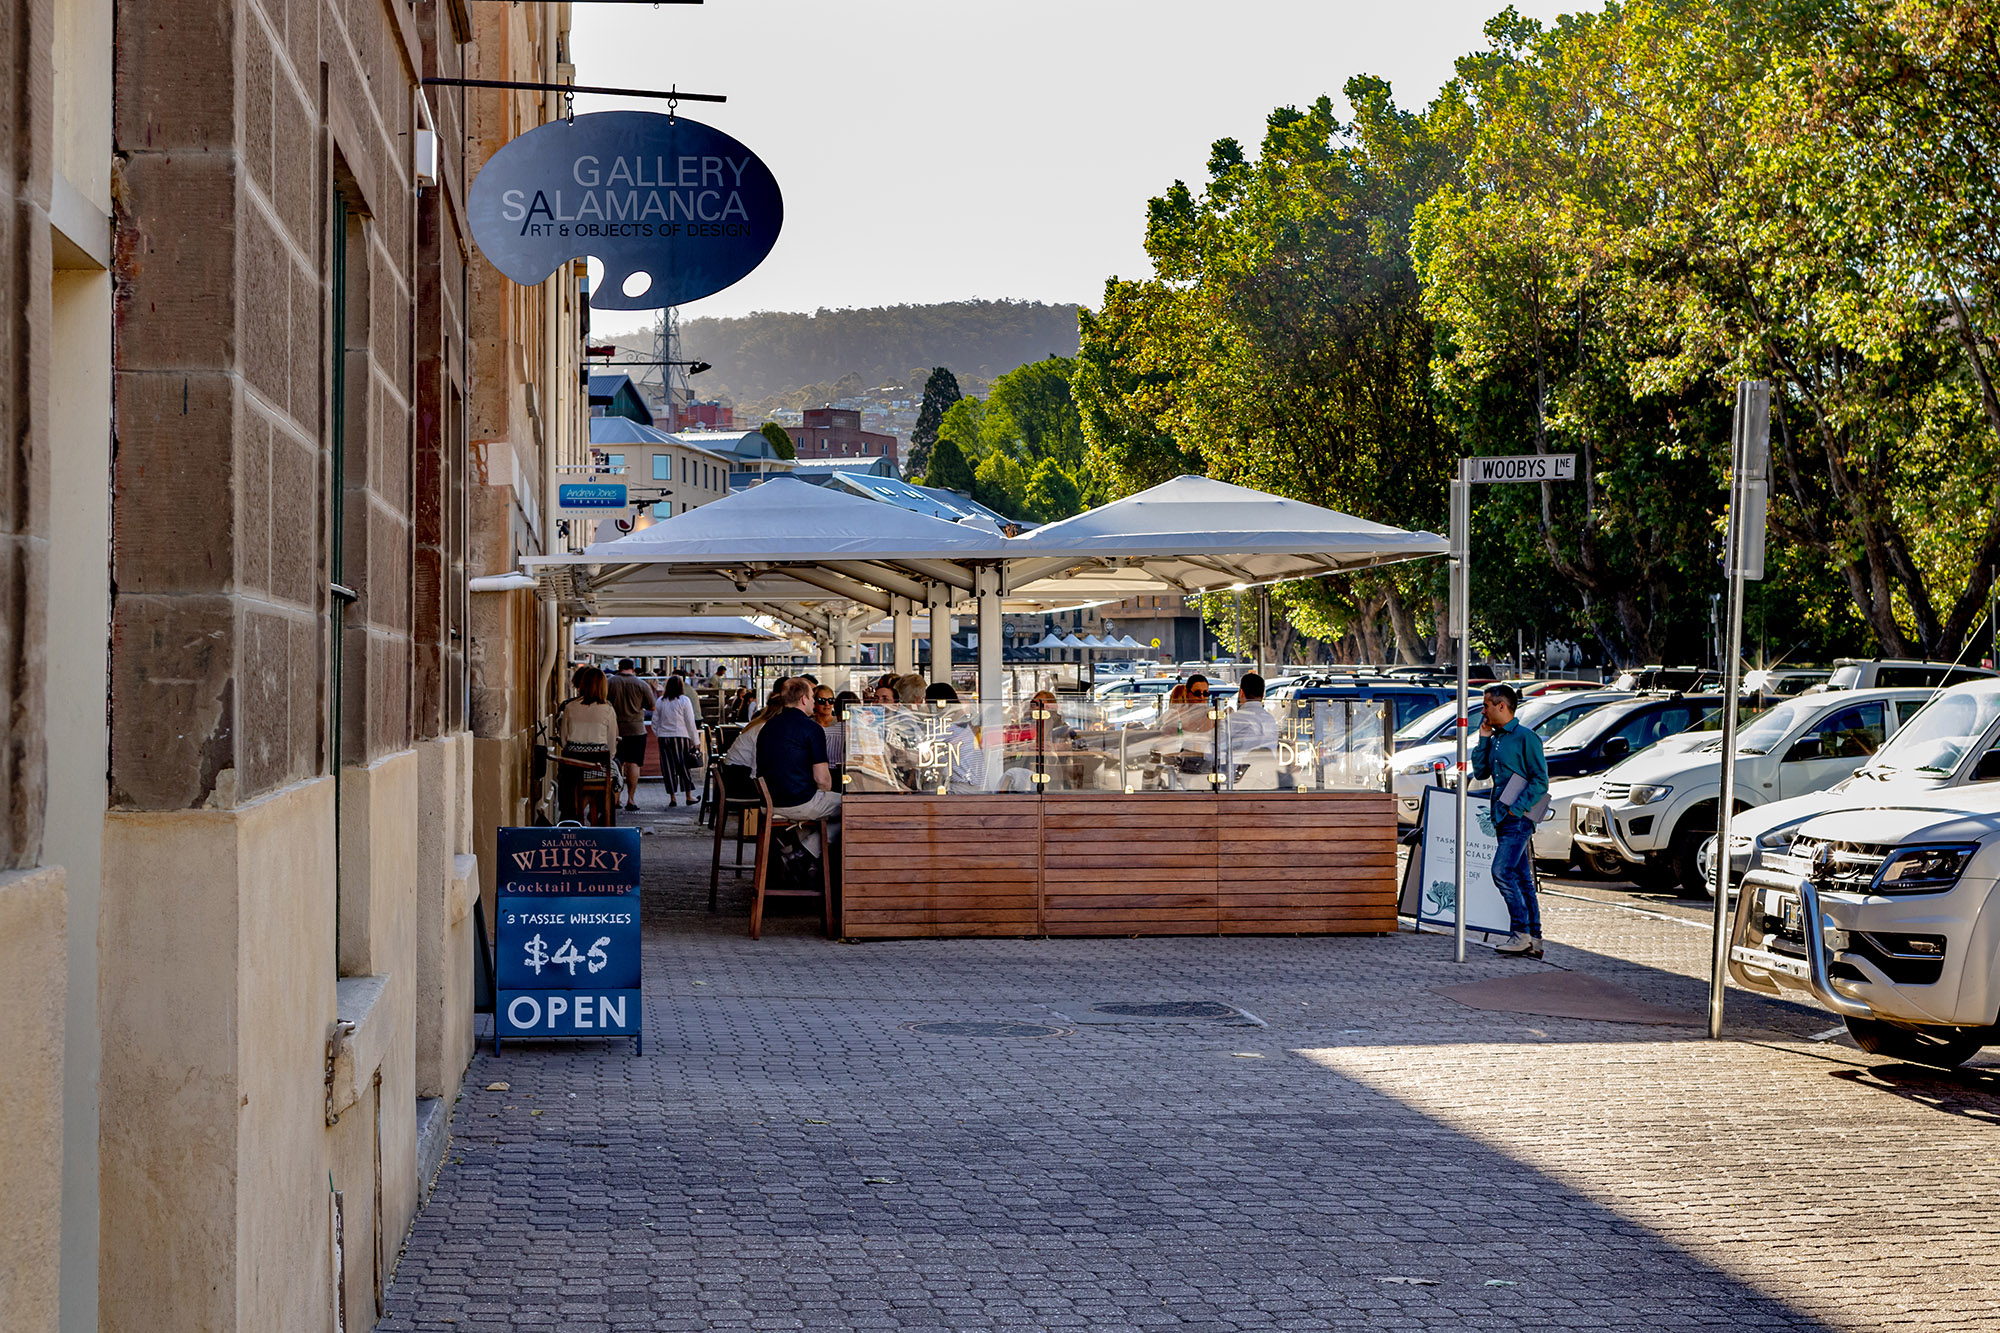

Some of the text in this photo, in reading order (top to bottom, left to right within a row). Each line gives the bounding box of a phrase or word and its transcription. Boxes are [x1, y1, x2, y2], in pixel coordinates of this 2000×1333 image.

[573, 155, 750, 187] GALLERY
[502, 189, 750, 222] SALAMANCA
[559, 223, 570, 237] &
[575, 223, 654, 237] OBJECTS
[659, 223, 681, 237] OF
[687, 223, 752, 237] DESIGN
[1482, 457, 1571, 479] WOOBYS LNE
[566, 488, 617, 497] Andrew Jones
[923, 717, 953, 741] THE
[1285, 717, 1314, 741] THE
[918, 741, 963, 776] DEN
[1278, 741, 1323, 776] DEN
[542, 839, 597, 847] SALAMANCA
[1436, 836, 1480, 849] TASMIAN
[1449, 847, 1492, 860] SCIALS
[511, 847, 628, 872] WHISKY
[506, 881, 632, 895] Cocktail Lounge
[506, 913, 631, 925] 3 TASSIE WHISKIES
[523, 933, 611, 976] $45
[507, 996, 626, 1029] OPEN
